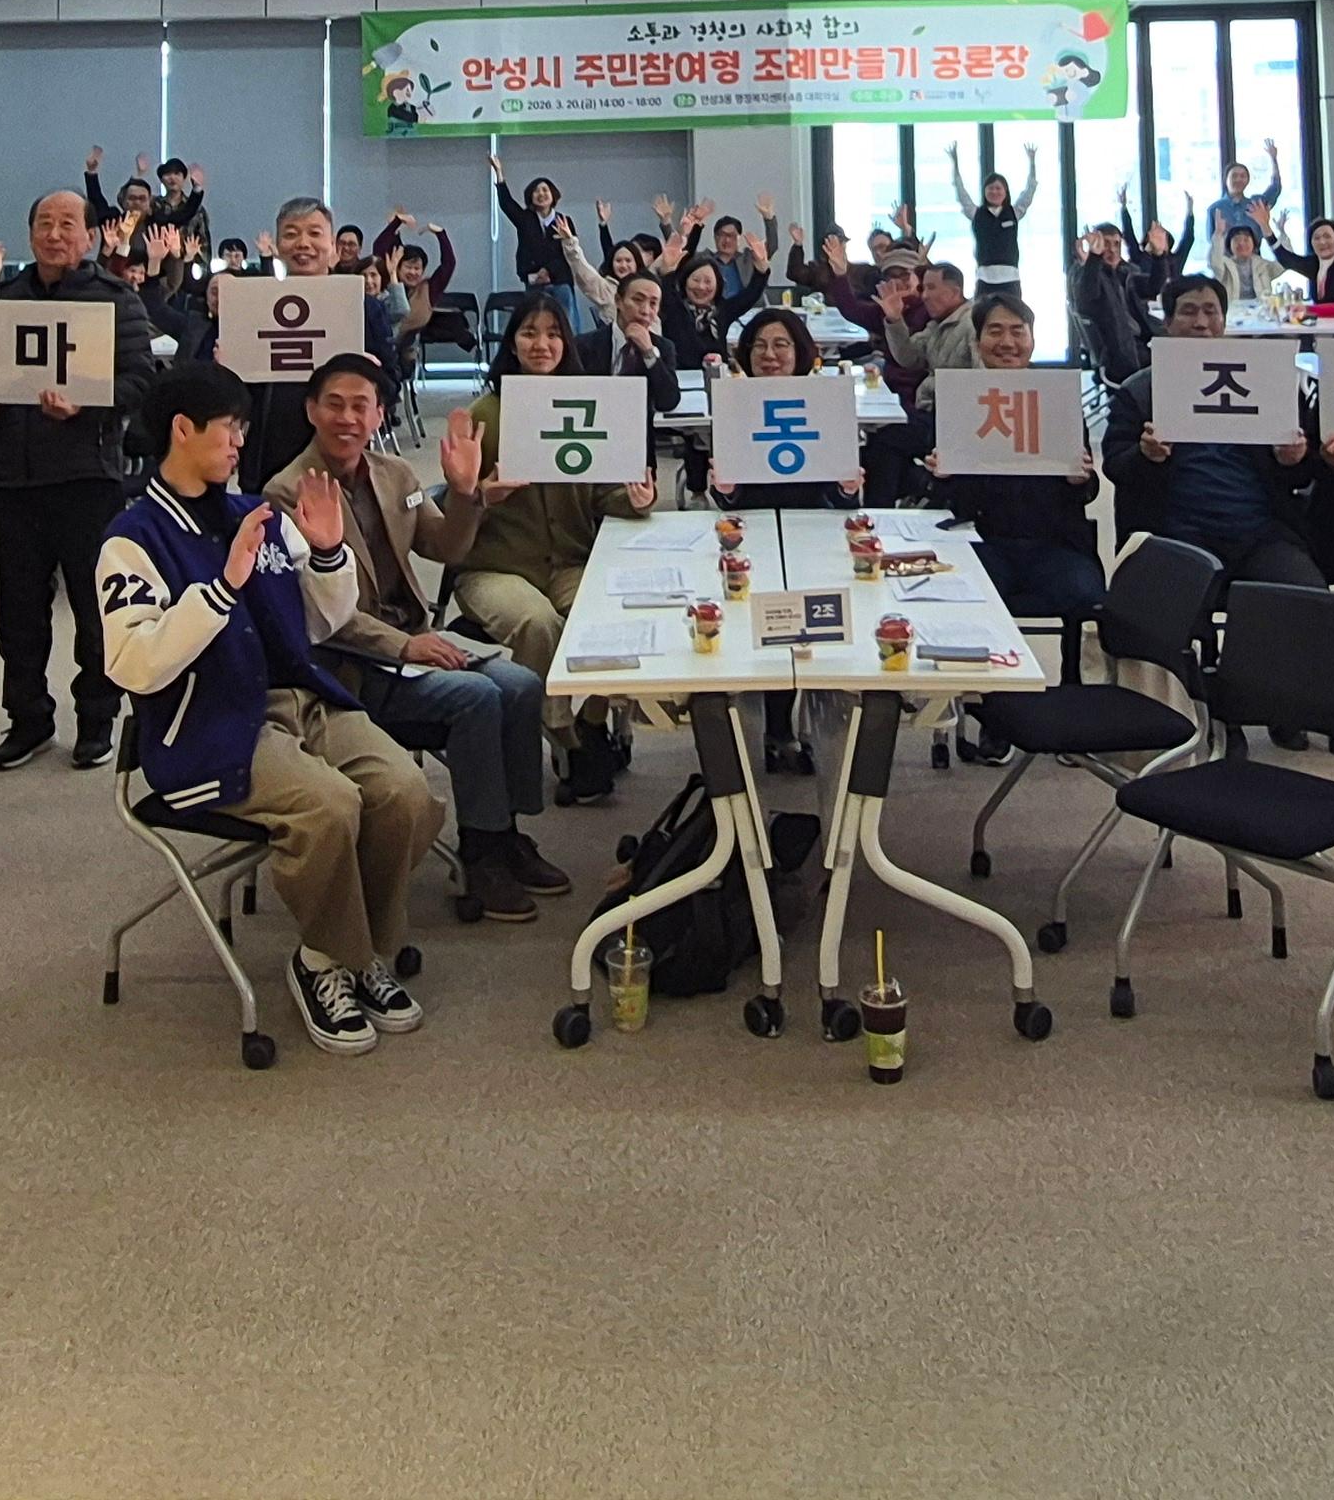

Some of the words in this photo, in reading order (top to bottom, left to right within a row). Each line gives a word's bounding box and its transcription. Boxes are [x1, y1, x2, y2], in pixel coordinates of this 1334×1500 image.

[627, 21, 681, 44] 소통과
[690, 20, 746, 42] 경청의
[756, 18, 812, 40] 사회적
[822, 14, 860, 39] 합의
[462, 56, 562, 91] 안성시
[574, 50, 741, 89] 주민참여형
[753, 47, 918, 81] 조례만들기
[932, 45, 1030, 80] 공론장
[15, 321, 76, 385] 마
[258, 294, 326, 371] 을
[1193, 361, 1259, 416] 조
[540, 398, 608, 475] 공
[752, 399, 820, 475] 동
[975, 387, 1041, 457] 체
[102, 572, 157, 616] 22
[811, 603, 836, 619] 2조
